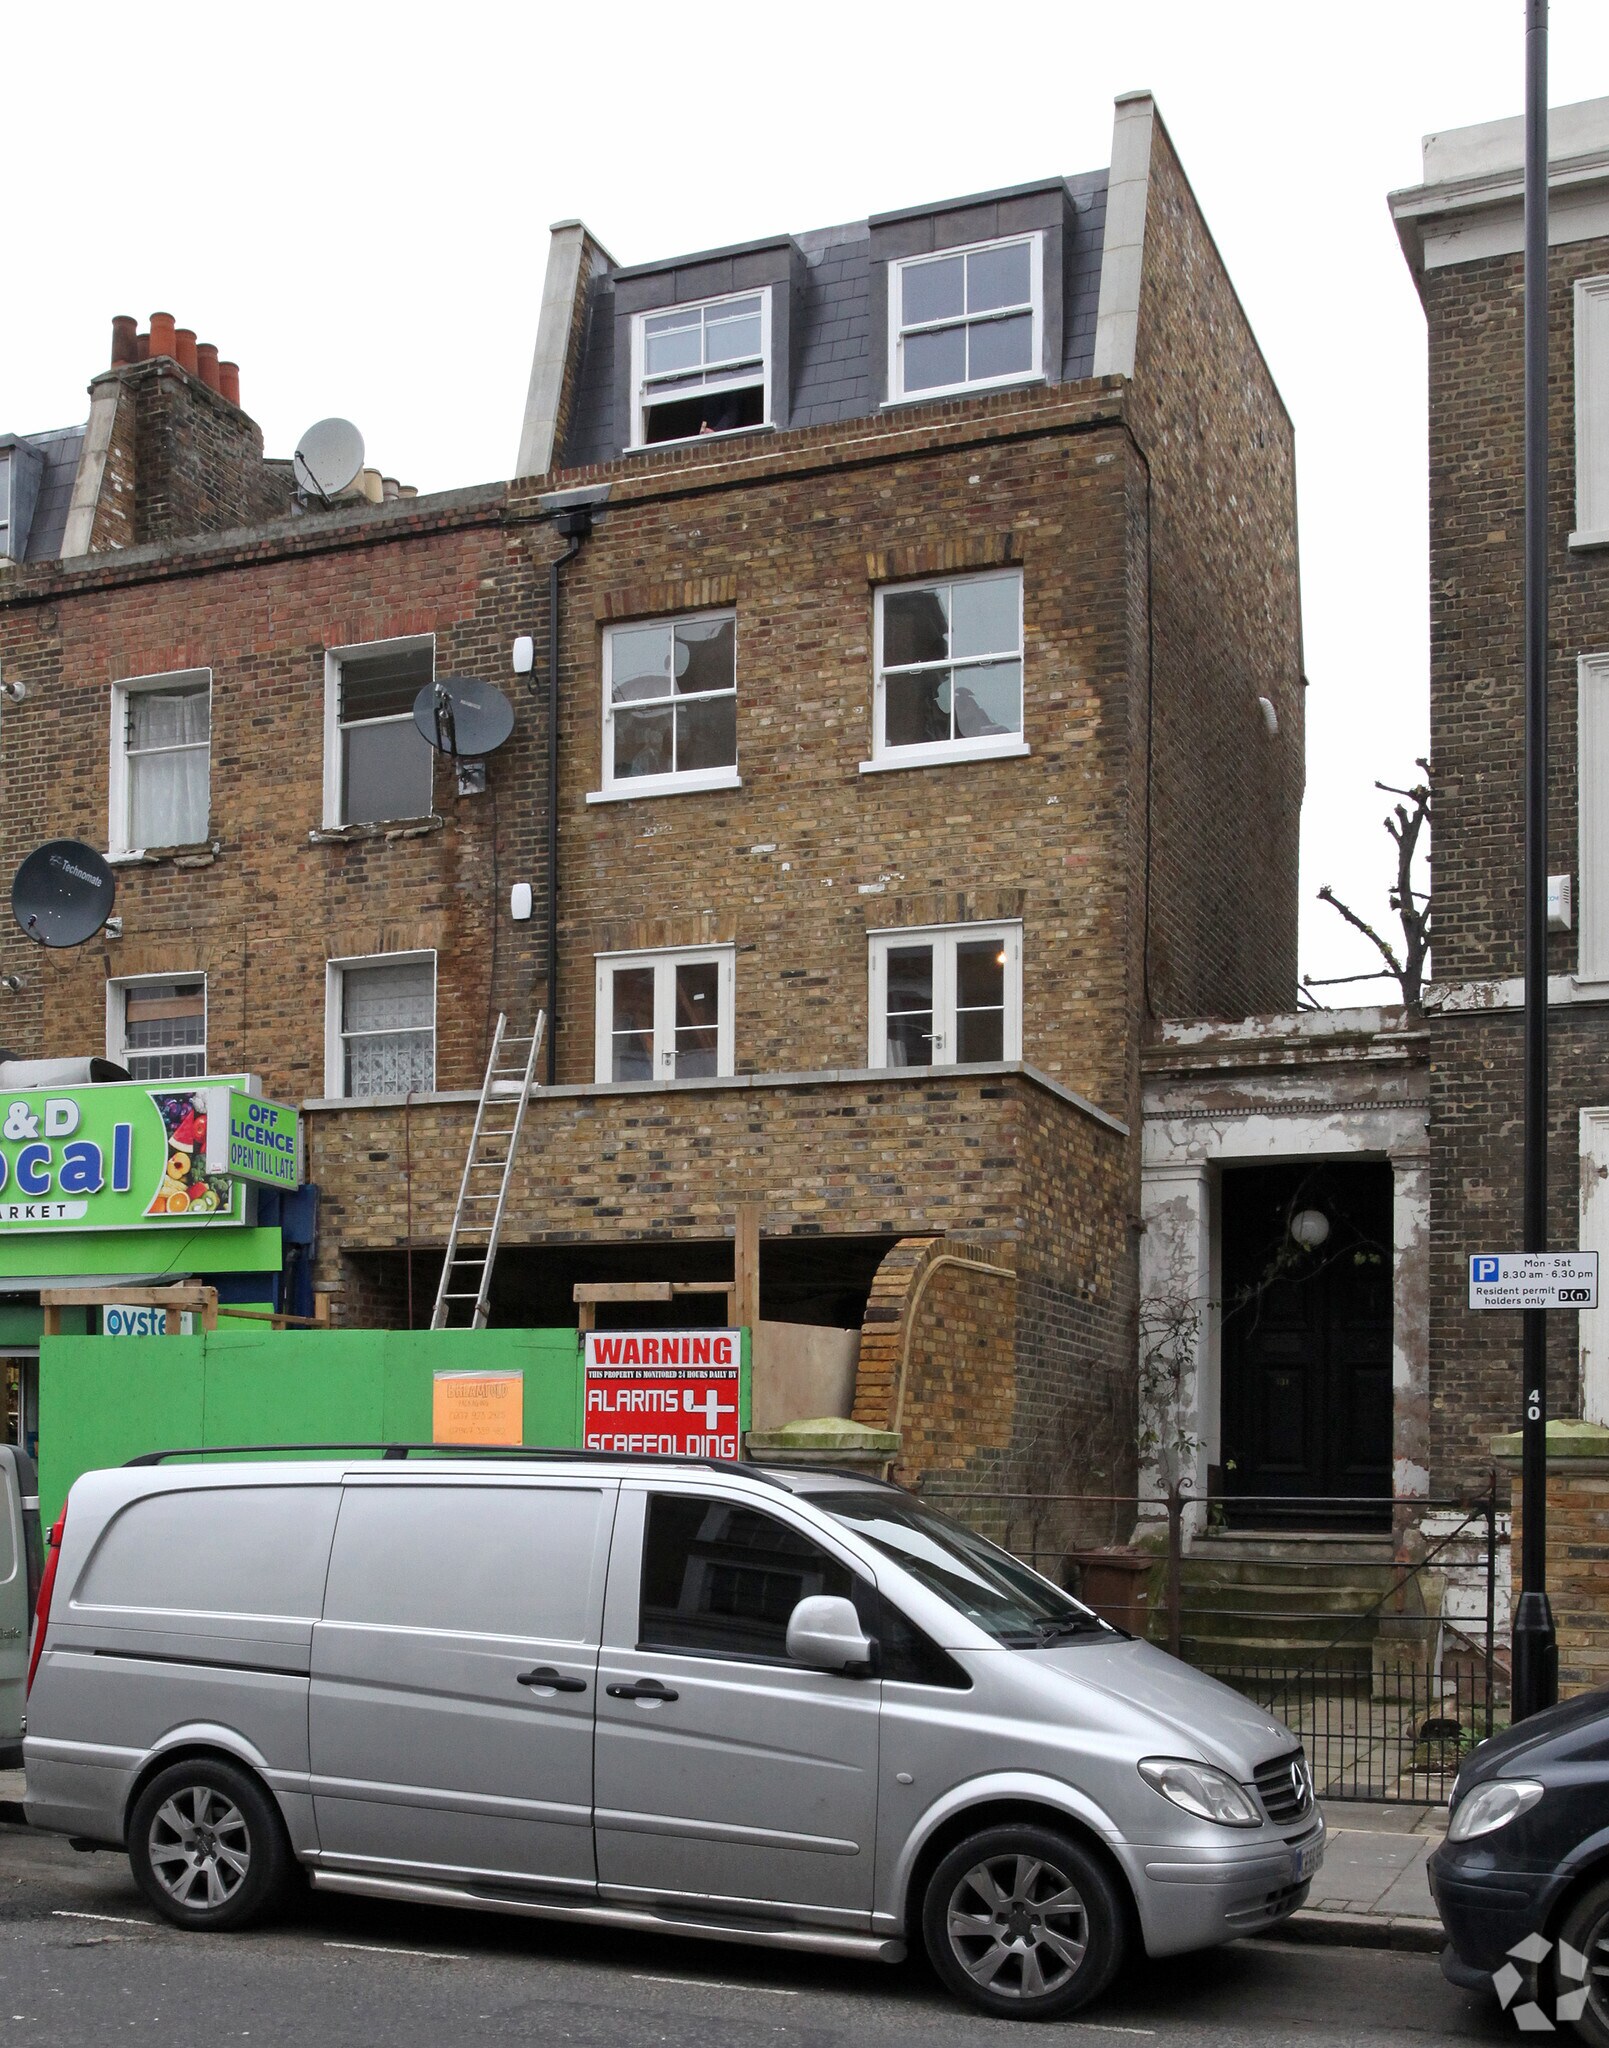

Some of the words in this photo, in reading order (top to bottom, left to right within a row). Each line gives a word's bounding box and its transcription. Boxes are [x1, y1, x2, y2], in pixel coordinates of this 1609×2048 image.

[62, 859, 103, 887] Technomate
[248, 1103, 279, 1127] OFF
[231, 1118, 295, 1155] LICENCE
[0, 1122, 132, 1196] cal
[231, 1143, 254, 1169] OPEN
[256, 1149, 273, 1175] TILL
[275, 1155, 294, 1180] LATE
[0, 1204, 66, 1219] RKET
[1502, 1270, 1527, 1279] 8.30
[1528, 1271, 1544, 1279] am
[1551, 1269, 1576, 1278] 6.30
[1578, 1271, 1593, 1279] pm
[1524, 1259, 1546, 1268] Mon
[1554, 1258, 1572, 1267] Sat
[1476, 1287, 1520, 1296] Resident
[1522, 1286, 1556, 1297] permit
[1484, 1296, 1522, 1305] holders
[1524, 1296, 1547, 1306] only
[1560, 1290, 1590, 1301] D(n)
[593, 1337, 732, 1364] WARNING
[588, 1370, 603, 1379] THIS
[603, 1370, 635, 1379] PROPERTY
[635, 1370, 642, 1378] IS
[643, 1370, 677, 1379] MONITORED
[677, 1370, 686, 1379] 24
[687, 1370, 708, 1379] HOURS
[709, 1370, 728, 1379] DAILY
[728, 1370, 737, 1379] BY
[588, 1389, 679, 1412] ALARMS
[587, 1434, 735, 1458] SCAFFOLDING
